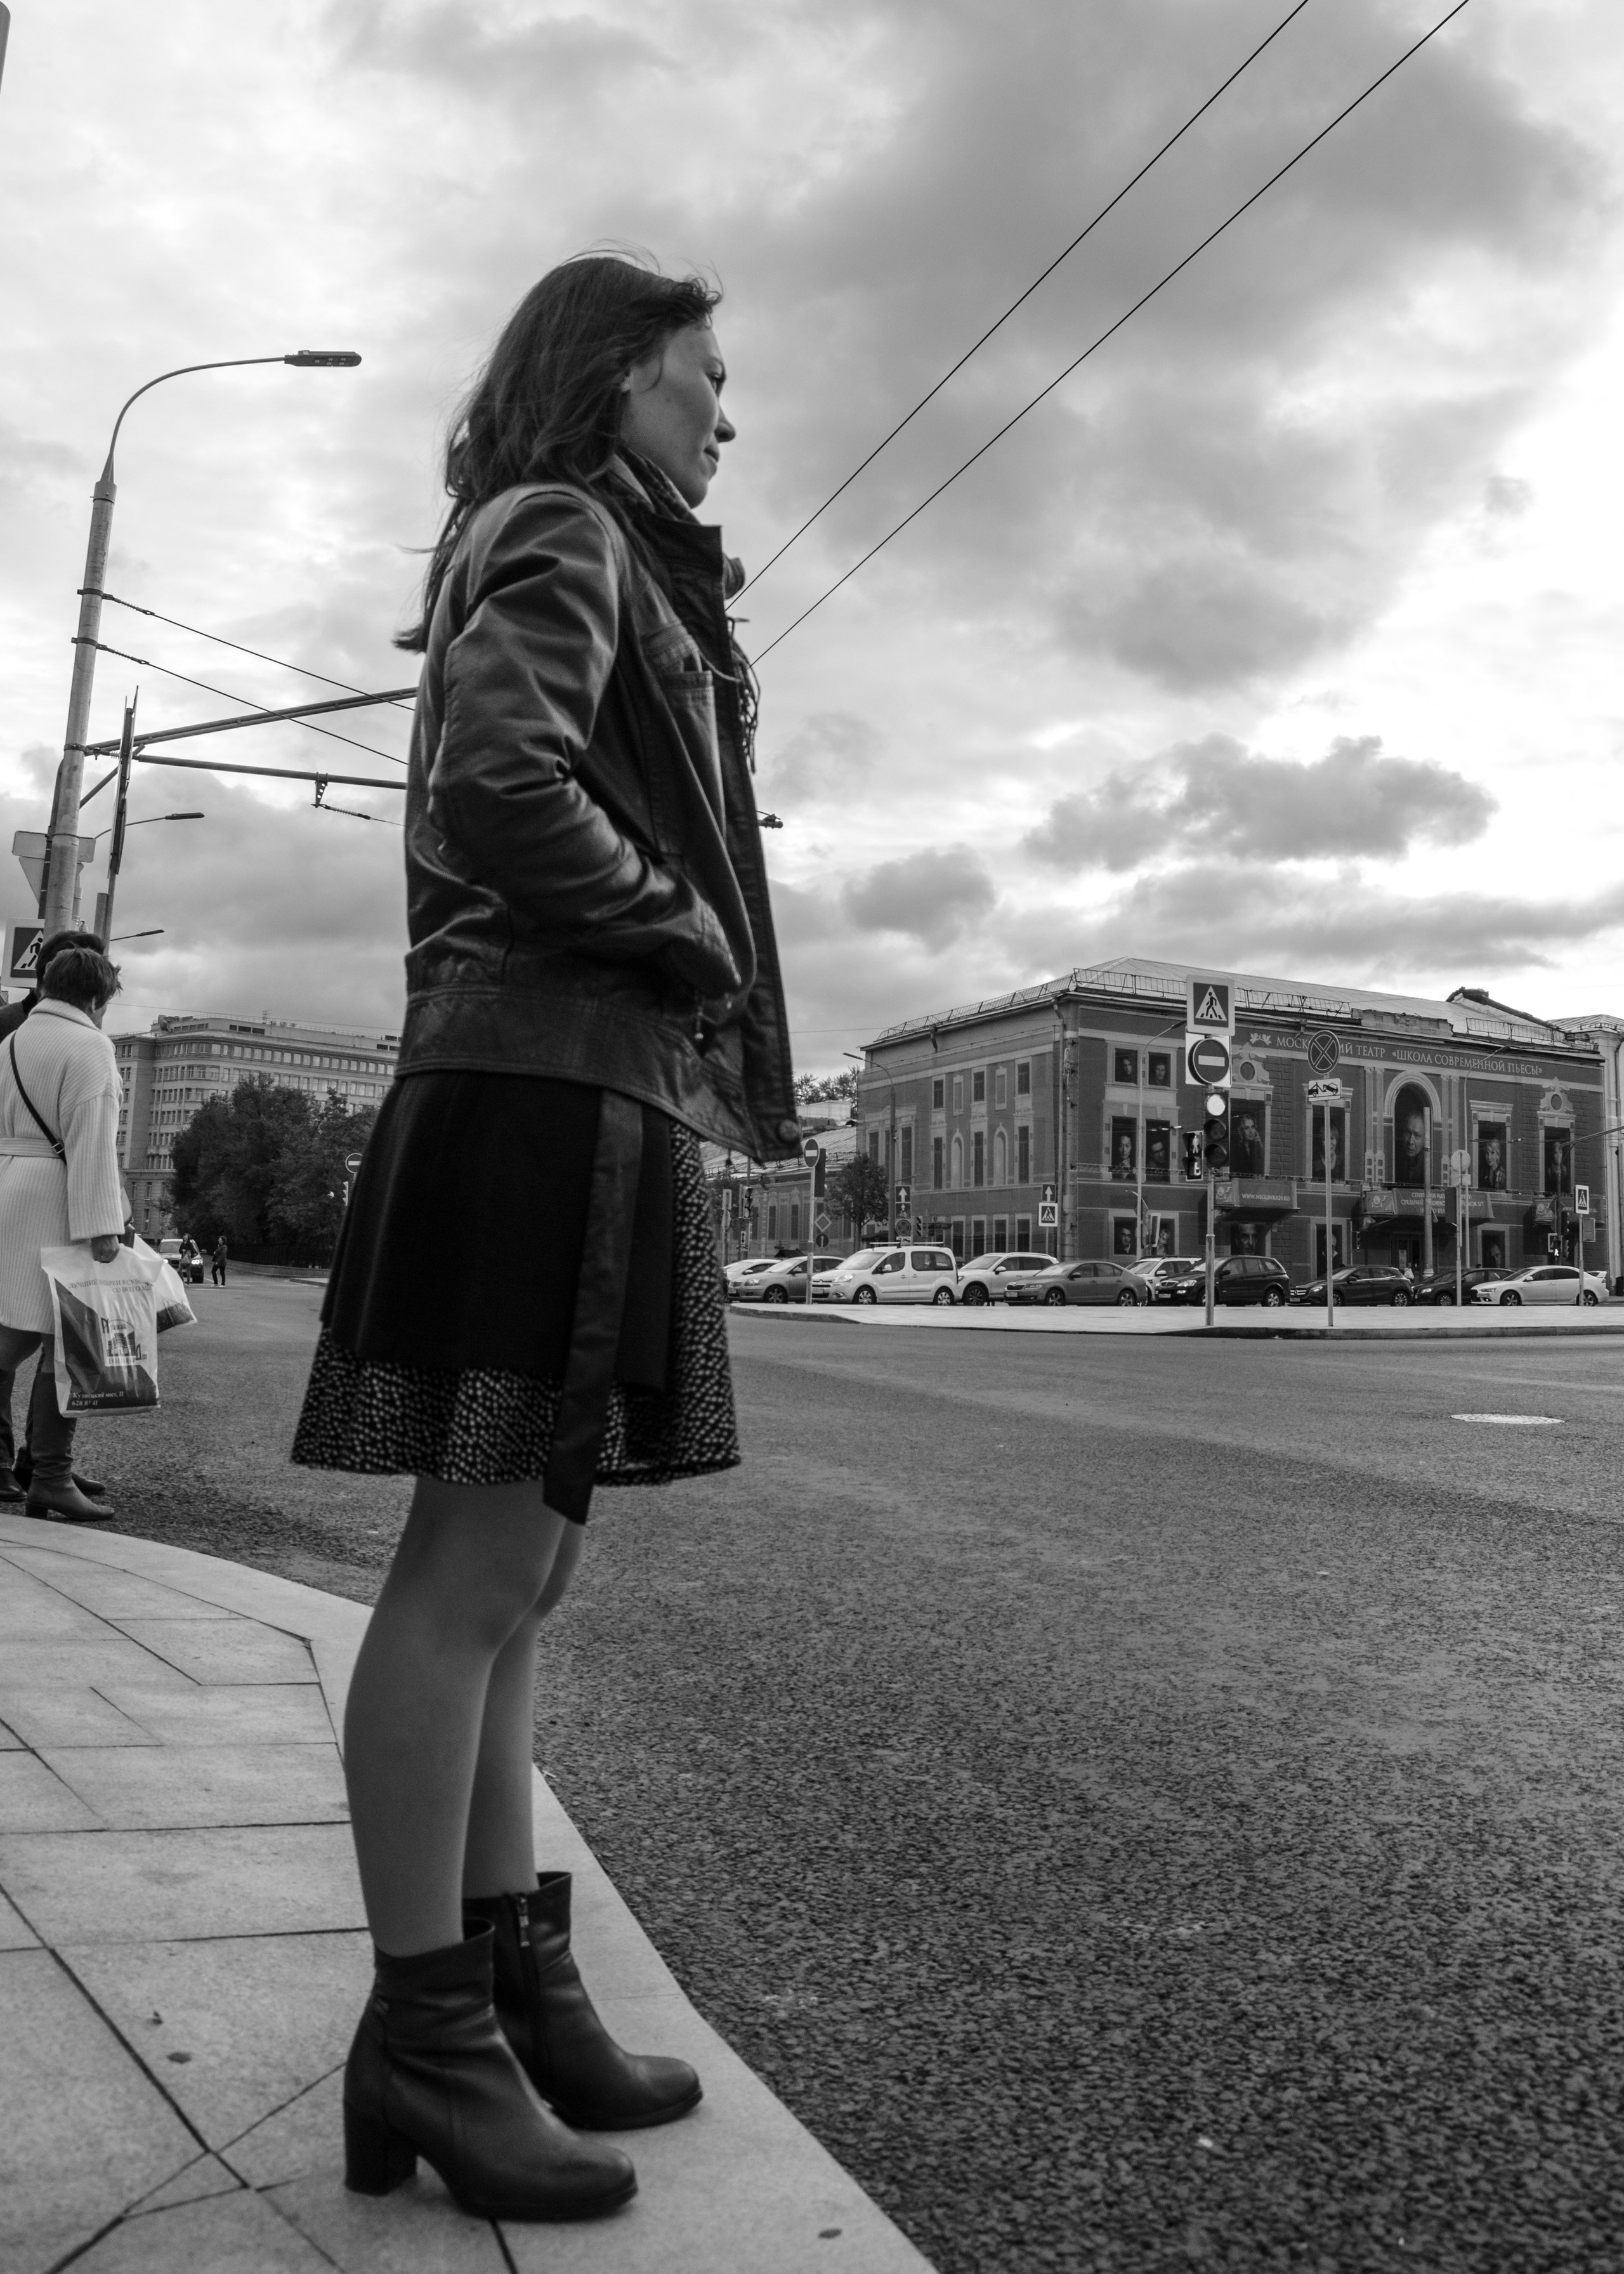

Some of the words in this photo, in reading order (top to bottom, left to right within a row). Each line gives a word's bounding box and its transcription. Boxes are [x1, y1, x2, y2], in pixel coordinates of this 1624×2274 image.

[1276, 1036, 1352, 1055] МОСКИЙ
[1356, 1045, 1385, 1058] ТЕАТР
[1392, 1049, 1432, 1064] «ШКОЛА
[1434, 1054, 1505, 1072] СОВРЕМЕННОЙ
[1507, 1063, 1543, 1075] ПЬЕСЫ»
